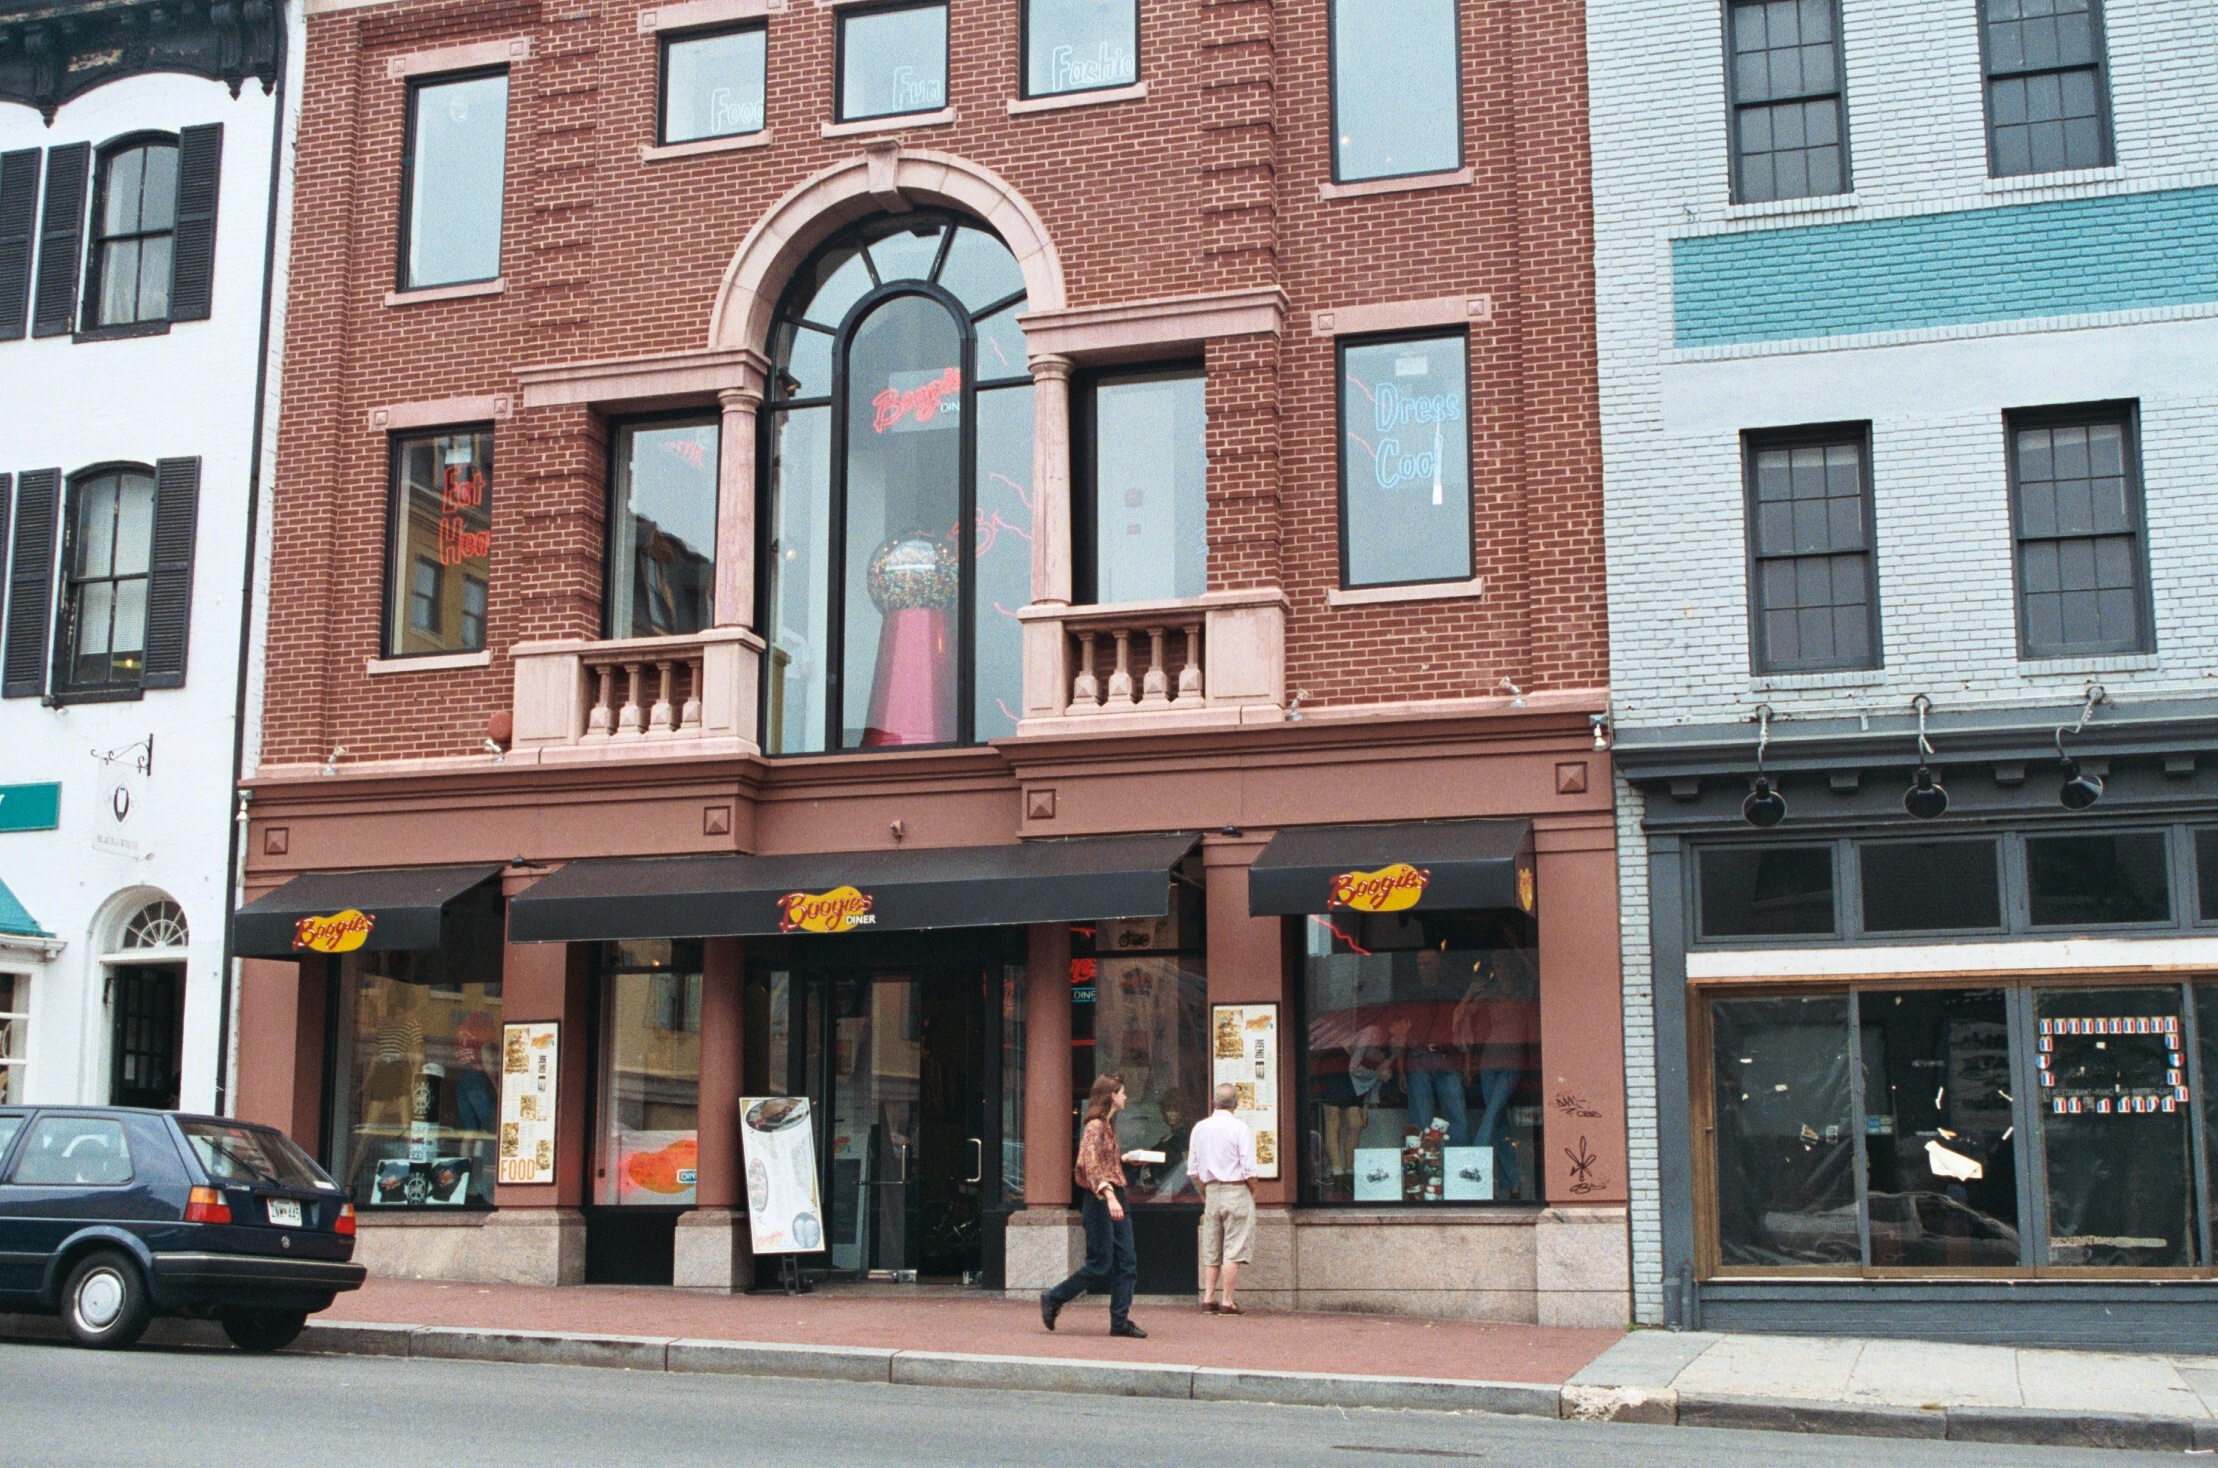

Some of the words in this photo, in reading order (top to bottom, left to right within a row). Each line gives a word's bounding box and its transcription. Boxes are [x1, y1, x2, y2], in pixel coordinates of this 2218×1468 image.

[893, 65, 940, 111] Fun
[1375, 383, 1460, 432] Dress
[1375, 438, 1443, 488] Cool
[442, 466, 486, 514] Eat
[1327, 867, 1430, 911] Boogies
[292, 913, 376, 951] Boogies
[776, 890, 873, 933] Boogies
[846, 915, 876, 924] DINER
[538, 1055, 547, 1074] MENU
[1254, 1039, 1265, 1059] MENU
[500, 1158, 535, 1181] FOOD
